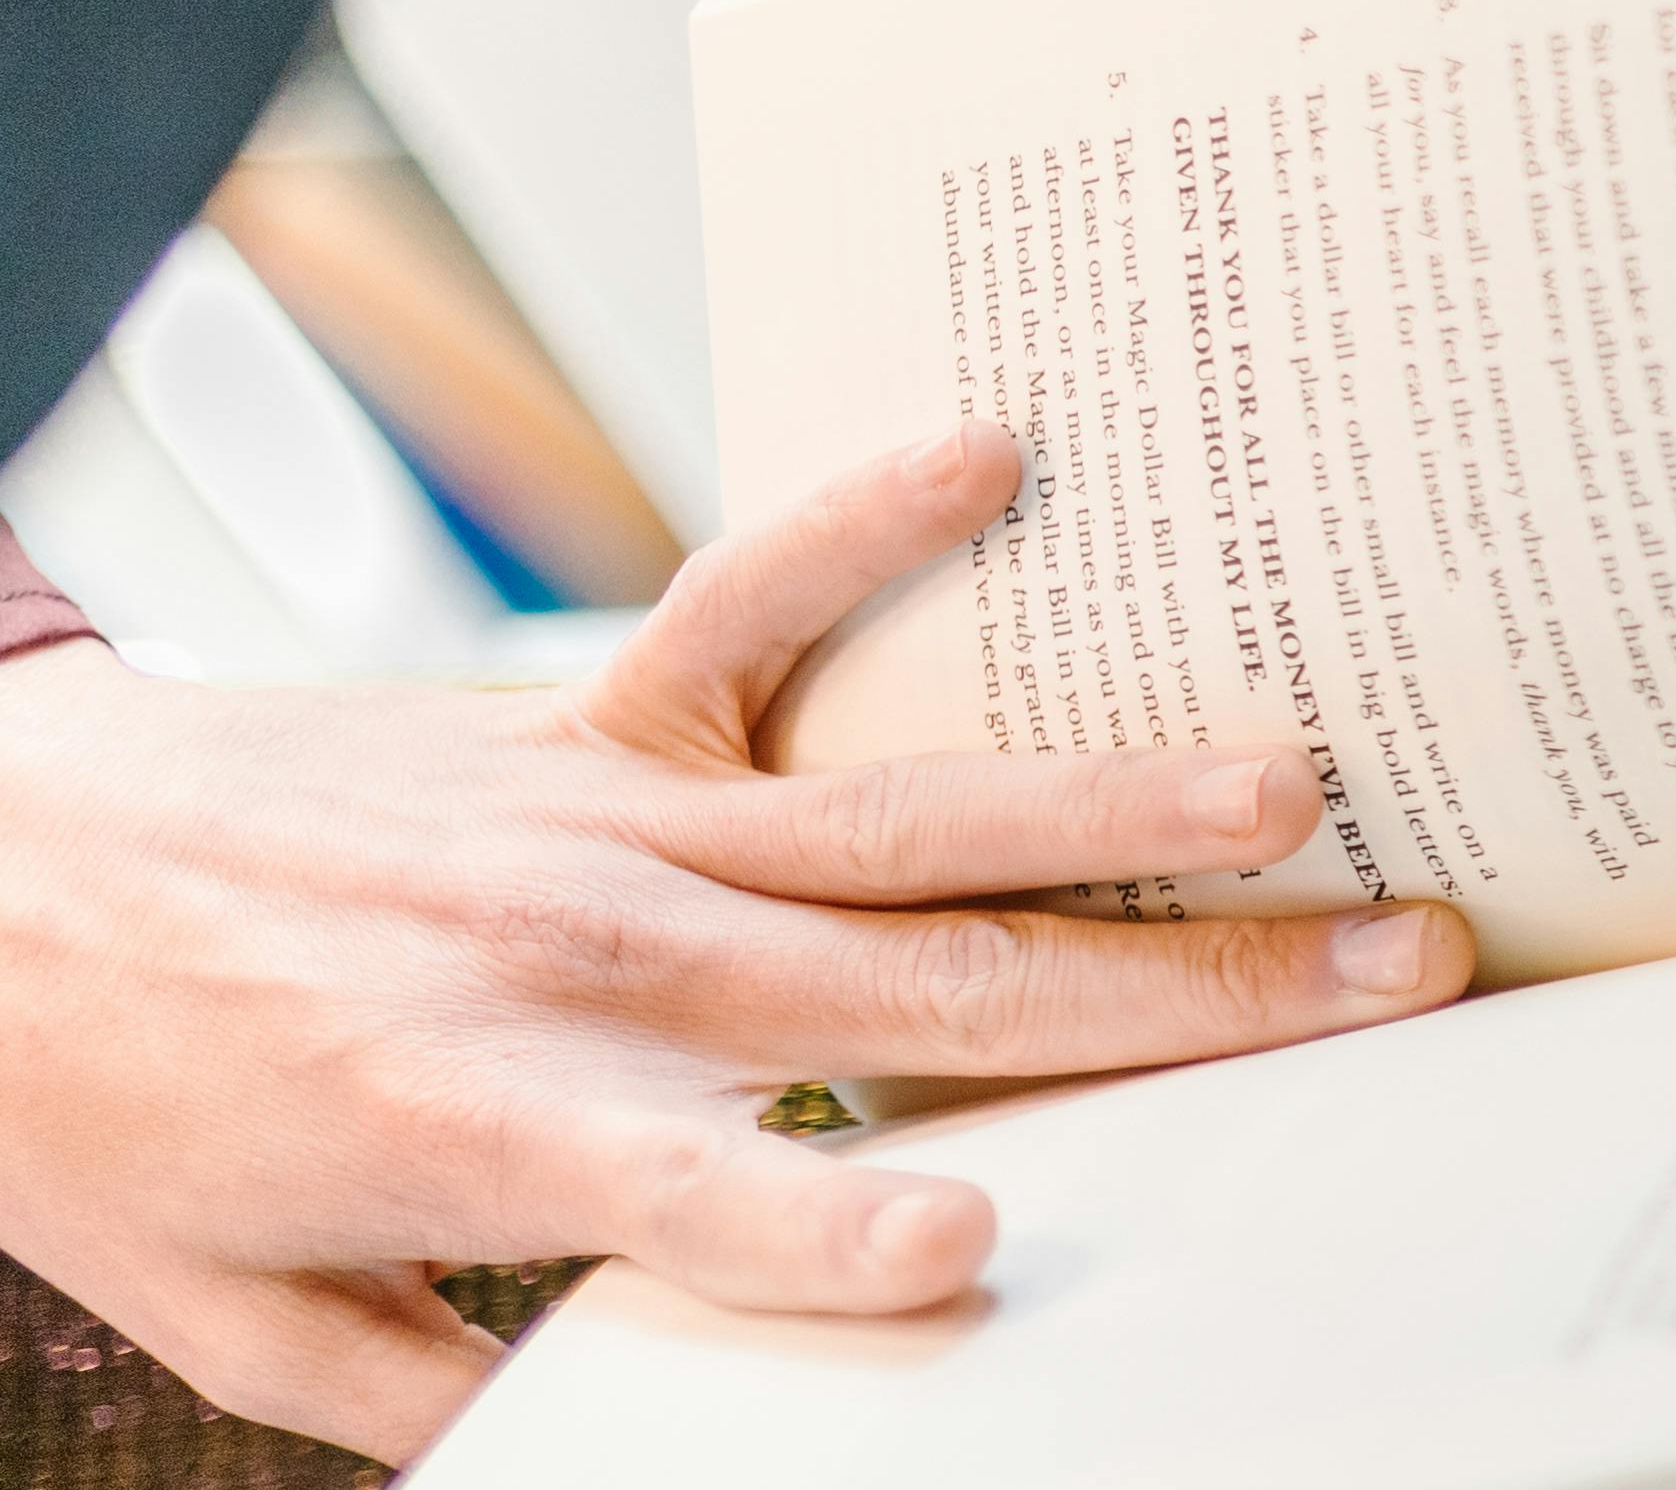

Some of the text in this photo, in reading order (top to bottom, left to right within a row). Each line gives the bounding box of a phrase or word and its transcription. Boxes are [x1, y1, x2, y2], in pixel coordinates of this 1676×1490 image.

[1007, 152, 1032, 216] and
[1206, 104, 1238, 244] THANK
[939, 169, 976, 386] abundance of
[1012, 222, 1039, 299] hold
[1220, 248, 1248, 331] YOU
[1019, 306, 1041, 360] the
[1228, 341, 1258, 421] FOR
[968, 159, 1037, 656] your written be truly
[1023, 368, 1048, 465] Magic
[1041, 144, 1116, 701] afternoon, or as many times as you
[1105, 69, 1201, 717] 5. Take your Magic Dollar Bill with you
[1170, 114, 1267, 694] GIVEN THROUGHOUT MY LIFE.
[1075, 137, 1168, 749] at least once in the morning and once
[1239, 429, 1269, 504] ALL
[1296, 25, 1499, 884] 4. Take a dollar bill or other small bill and write on a
[1034, 473, 1062, 575] Dollar
[1265, 92, 1463, 898] sticker that you place on the bill in big bold letters:
[1252, 507, 1287, 591] THE
[1045, 583, 1073, 641] Bill
[1054, 647, 1077, 683] in
[1268, 597, 1324, 734] MONEY
[1334, 819, 1398, 906] BEEN
